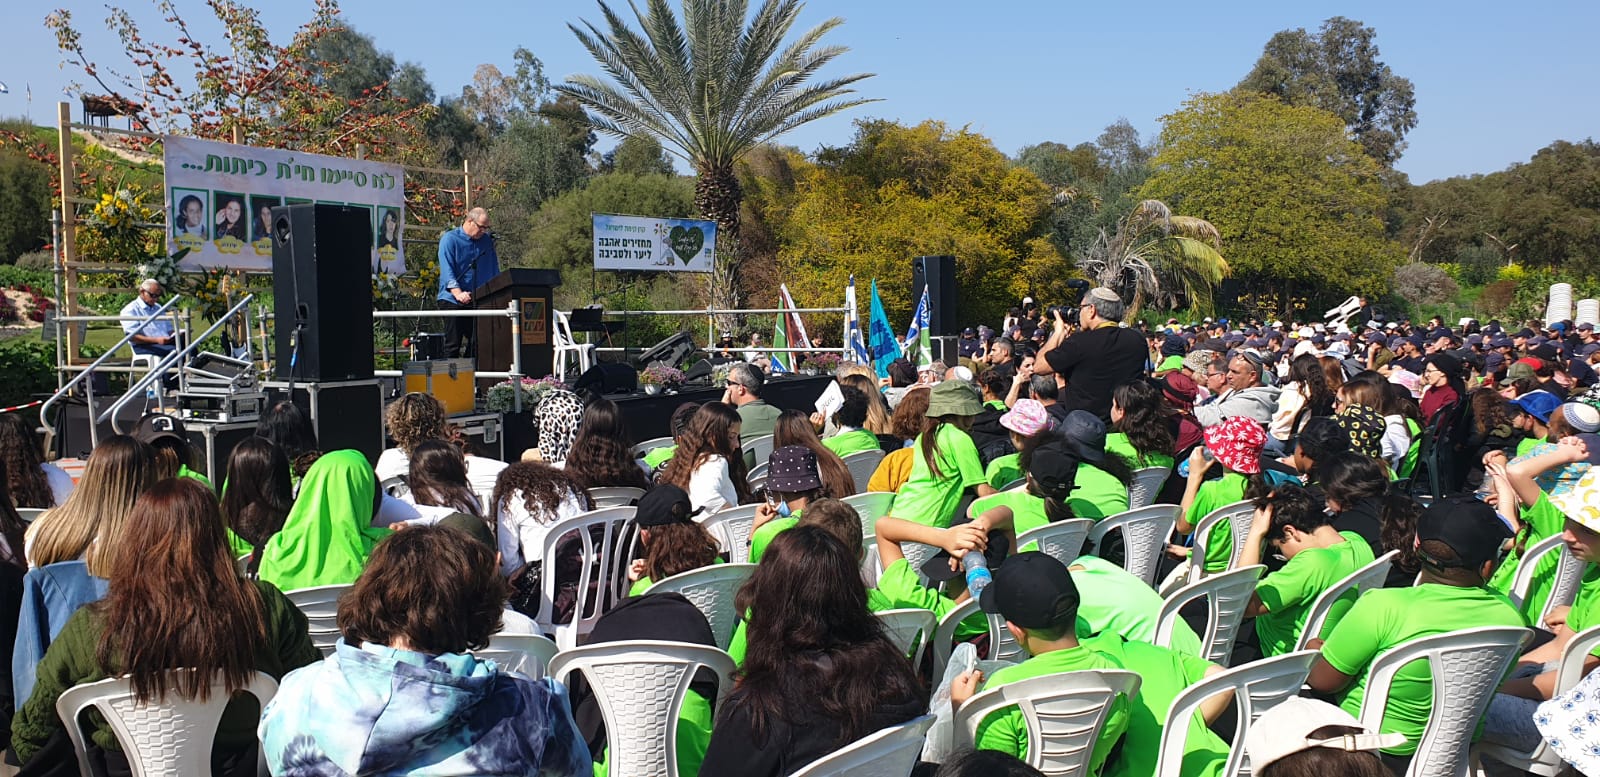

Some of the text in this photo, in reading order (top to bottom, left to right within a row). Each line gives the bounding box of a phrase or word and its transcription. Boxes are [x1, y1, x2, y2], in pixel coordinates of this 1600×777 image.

[181, 153, 268, 176] כיתות...
[320, 167, 367, 188] סיימו
[372, 170, 395, 191] לא
[598, 237, 652, 248] מחזירים אהבה
[598, 248, 652, 260] ליער ולסביבה
